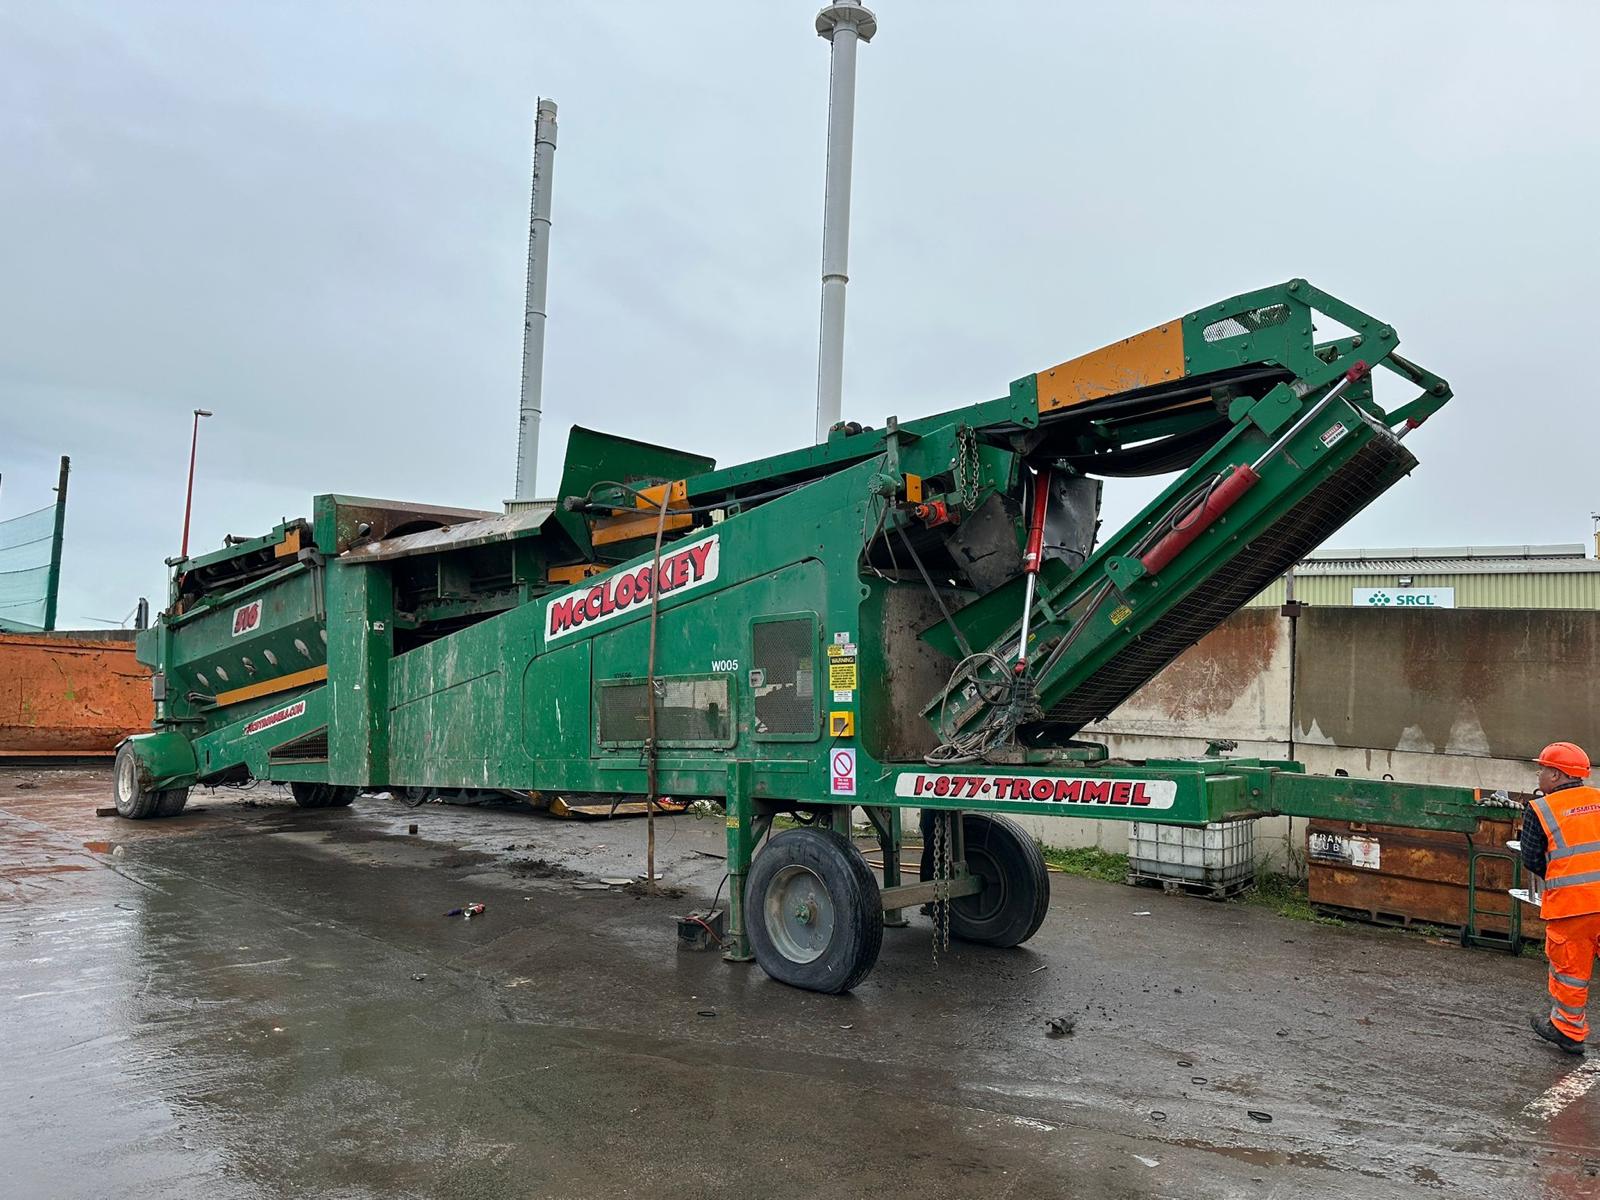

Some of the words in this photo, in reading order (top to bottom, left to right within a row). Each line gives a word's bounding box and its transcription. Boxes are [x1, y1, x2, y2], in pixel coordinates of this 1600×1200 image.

[550, 540, 714, 635] McCLOSKEY
[1396, 595, 1434, 605] SRCL
[711, 659, 739, 671] W005
